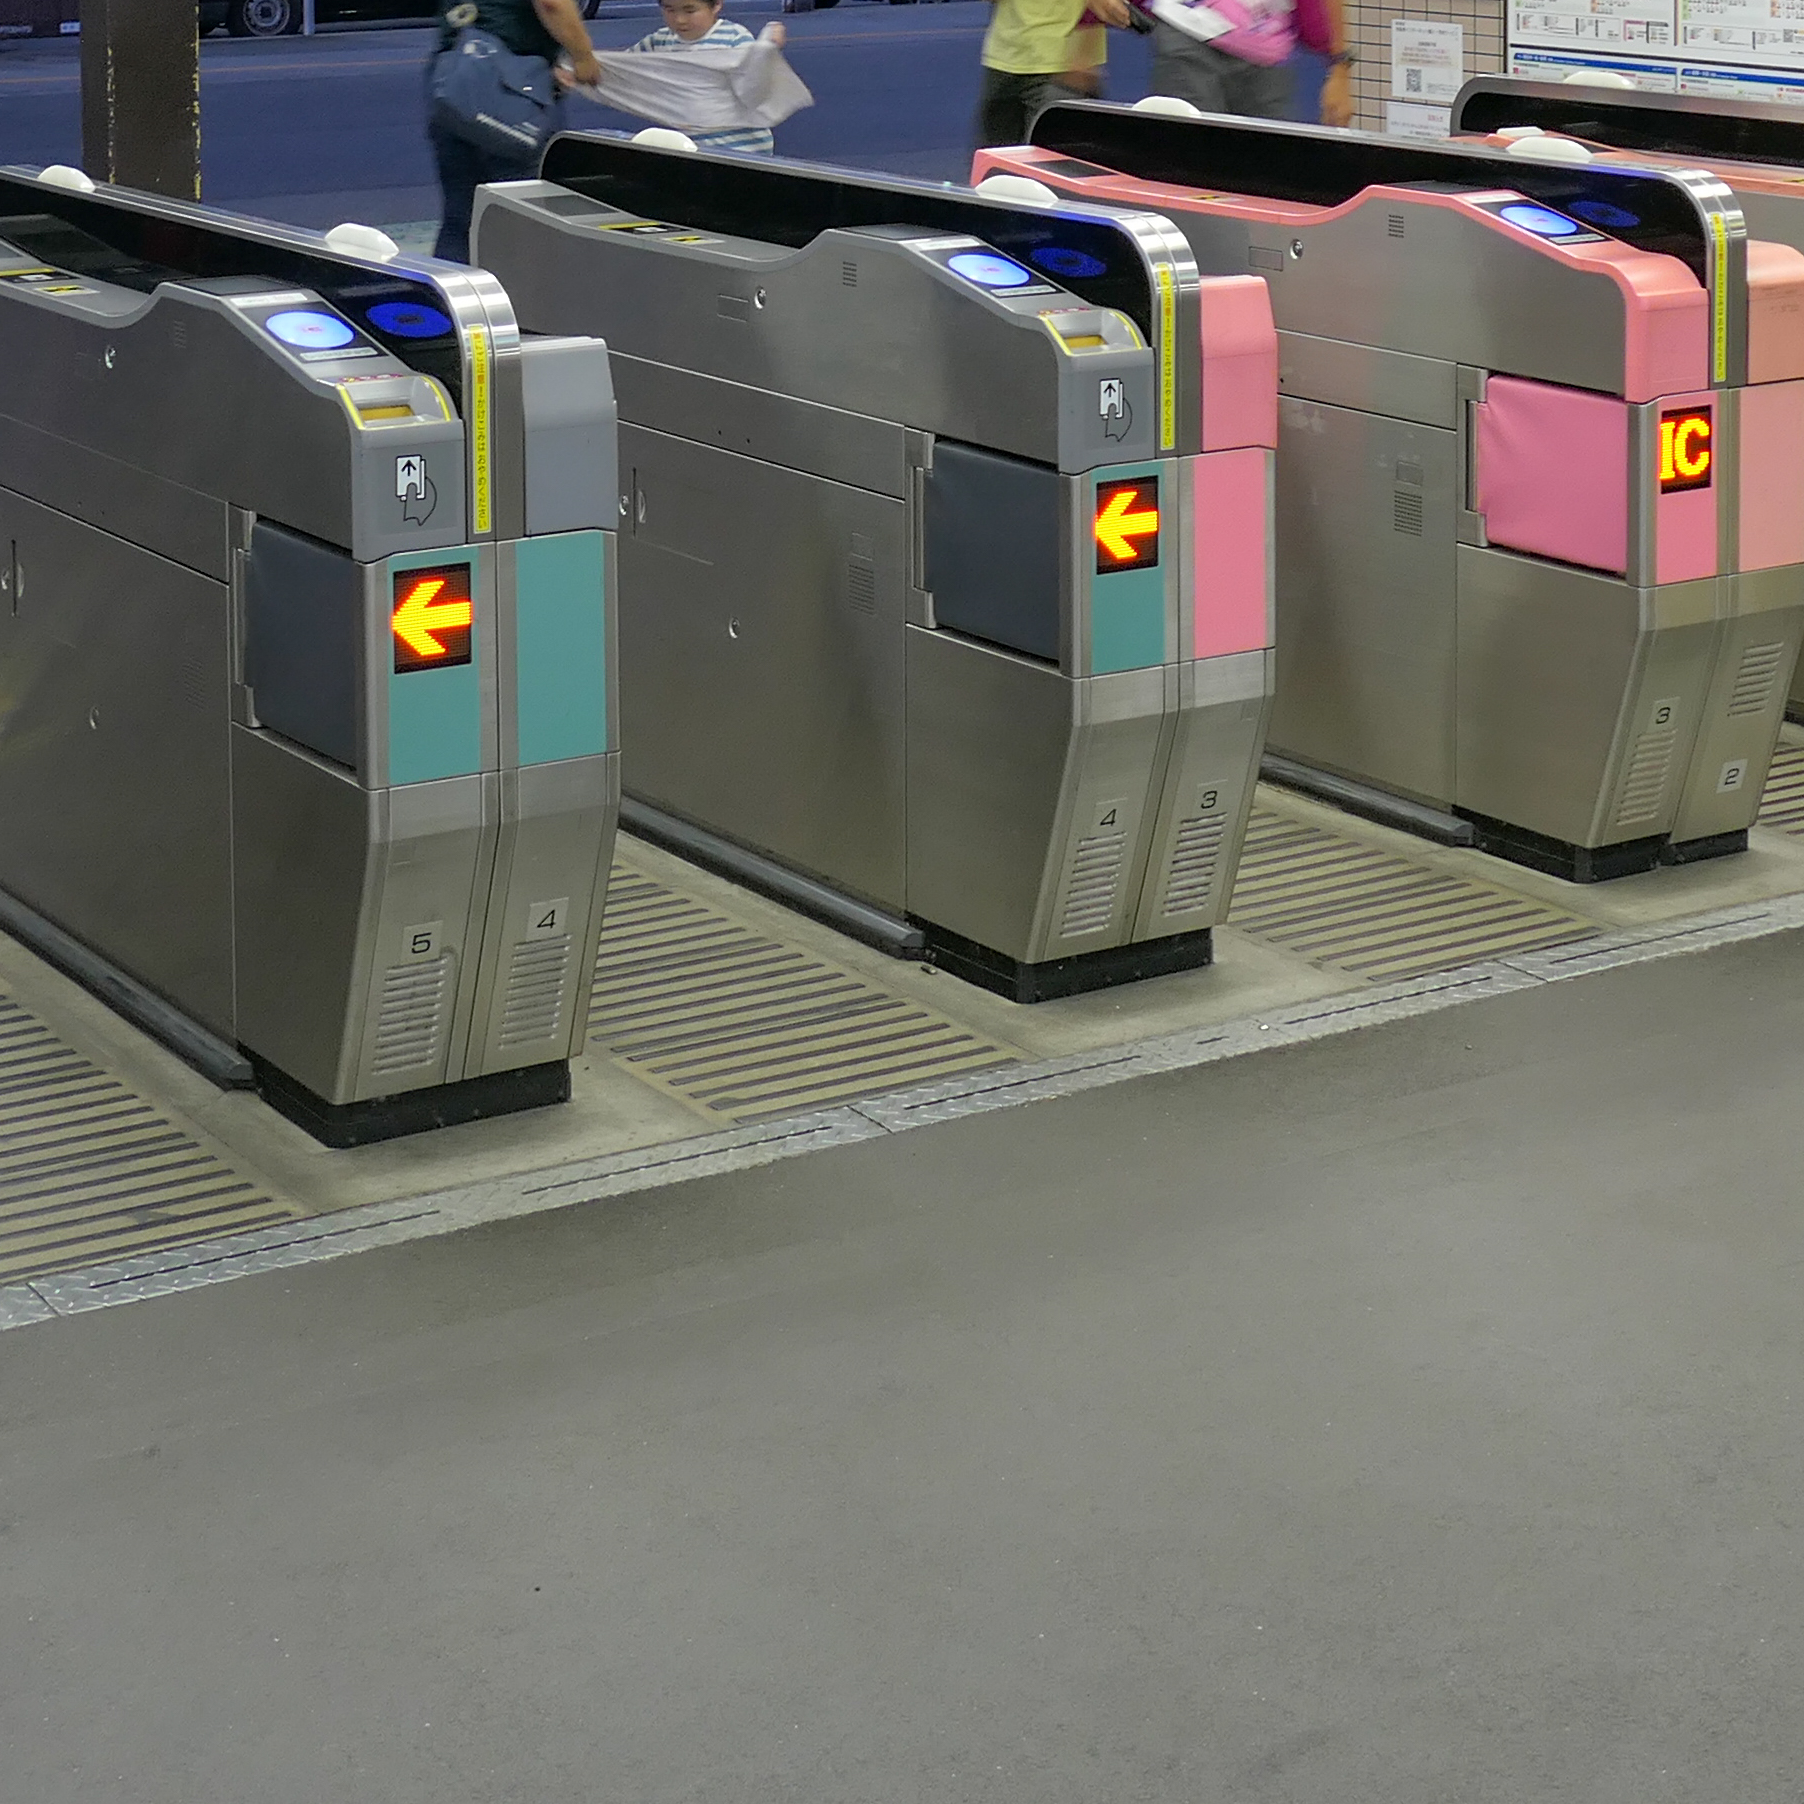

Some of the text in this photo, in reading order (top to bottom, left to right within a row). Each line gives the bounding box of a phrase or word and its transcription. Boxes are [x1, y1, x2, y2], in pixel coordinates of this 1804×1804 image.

[1660, 416, 1712, 482] IC
[1655, 707, 1672, 725] 3
[1724, 768, 1741, 786] 2
[1201, 789, 1218, 809] 3
[1100, 808, 1118, 828] 4
[537, 907, 556, 931] 4
[411, 931, 431, 955] 5
